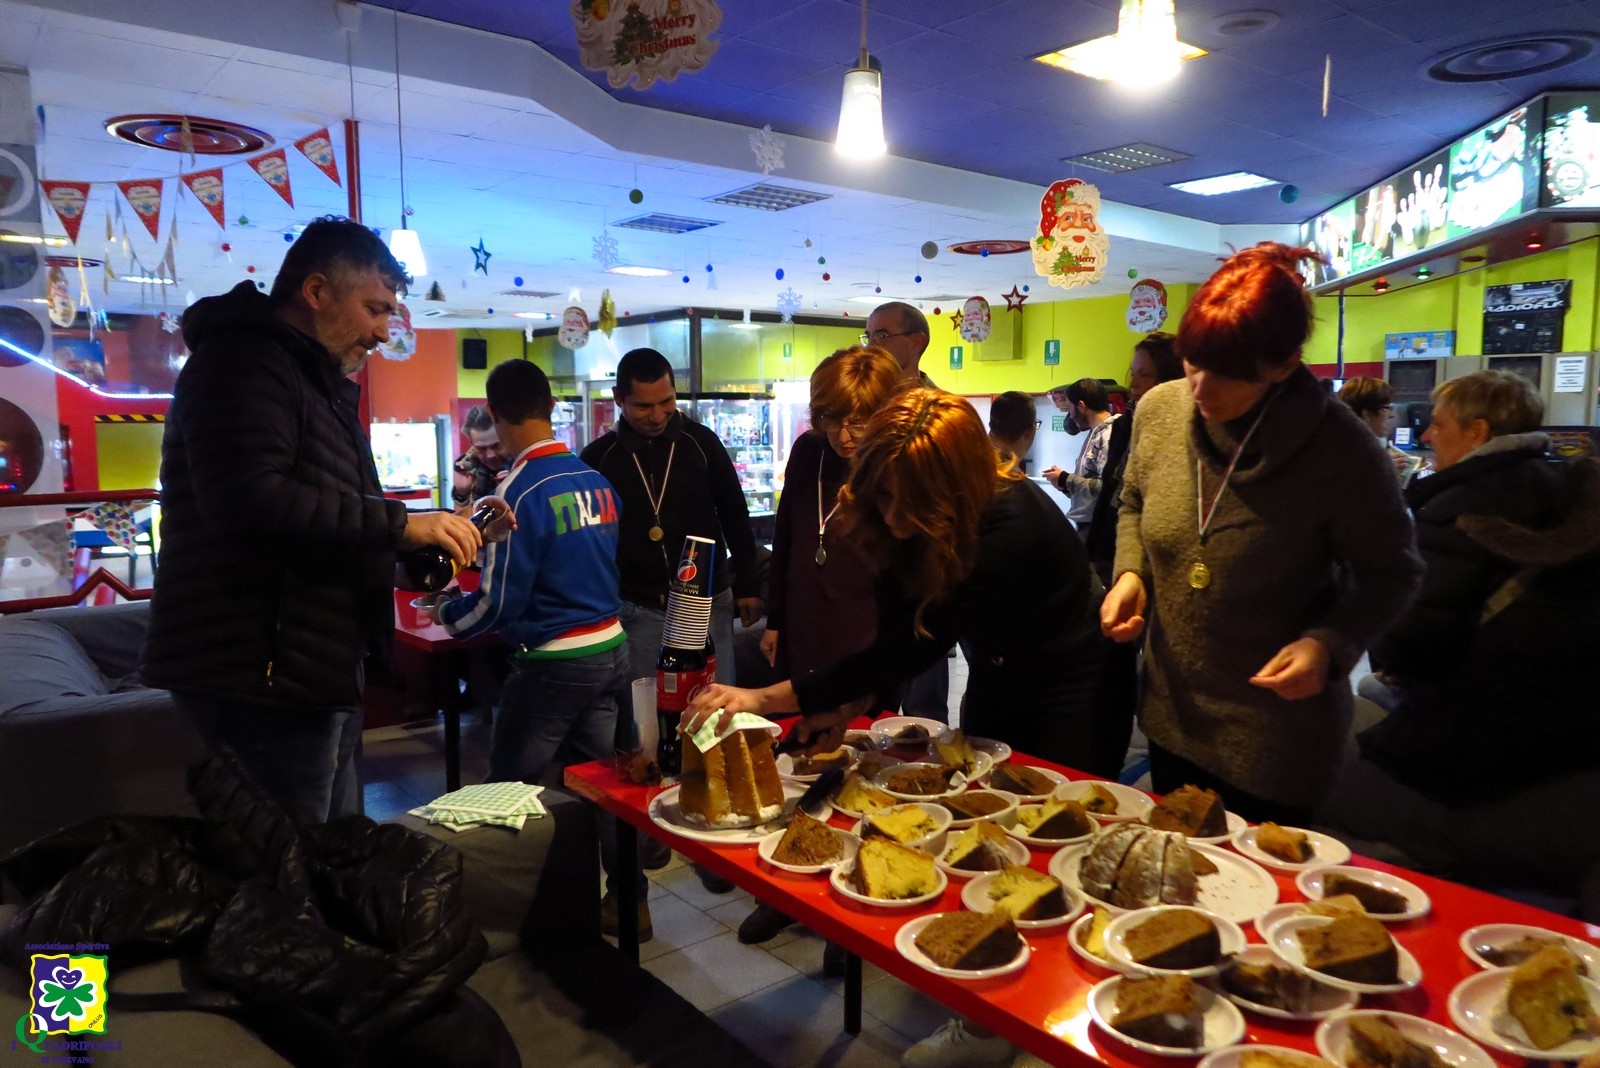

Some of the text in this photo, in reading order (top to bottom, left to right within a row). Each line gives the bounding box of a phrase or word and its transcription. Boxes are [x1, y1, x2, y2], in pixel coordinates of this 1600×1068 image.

[652, 13, 696, 31] Merry
[628, 33, 696, 56] Christmas
[1061, 264, 1095, 272] Christmas
[1074, 255, 1096, 264] Merry
[548, 488, 619, 536] ITALIA
